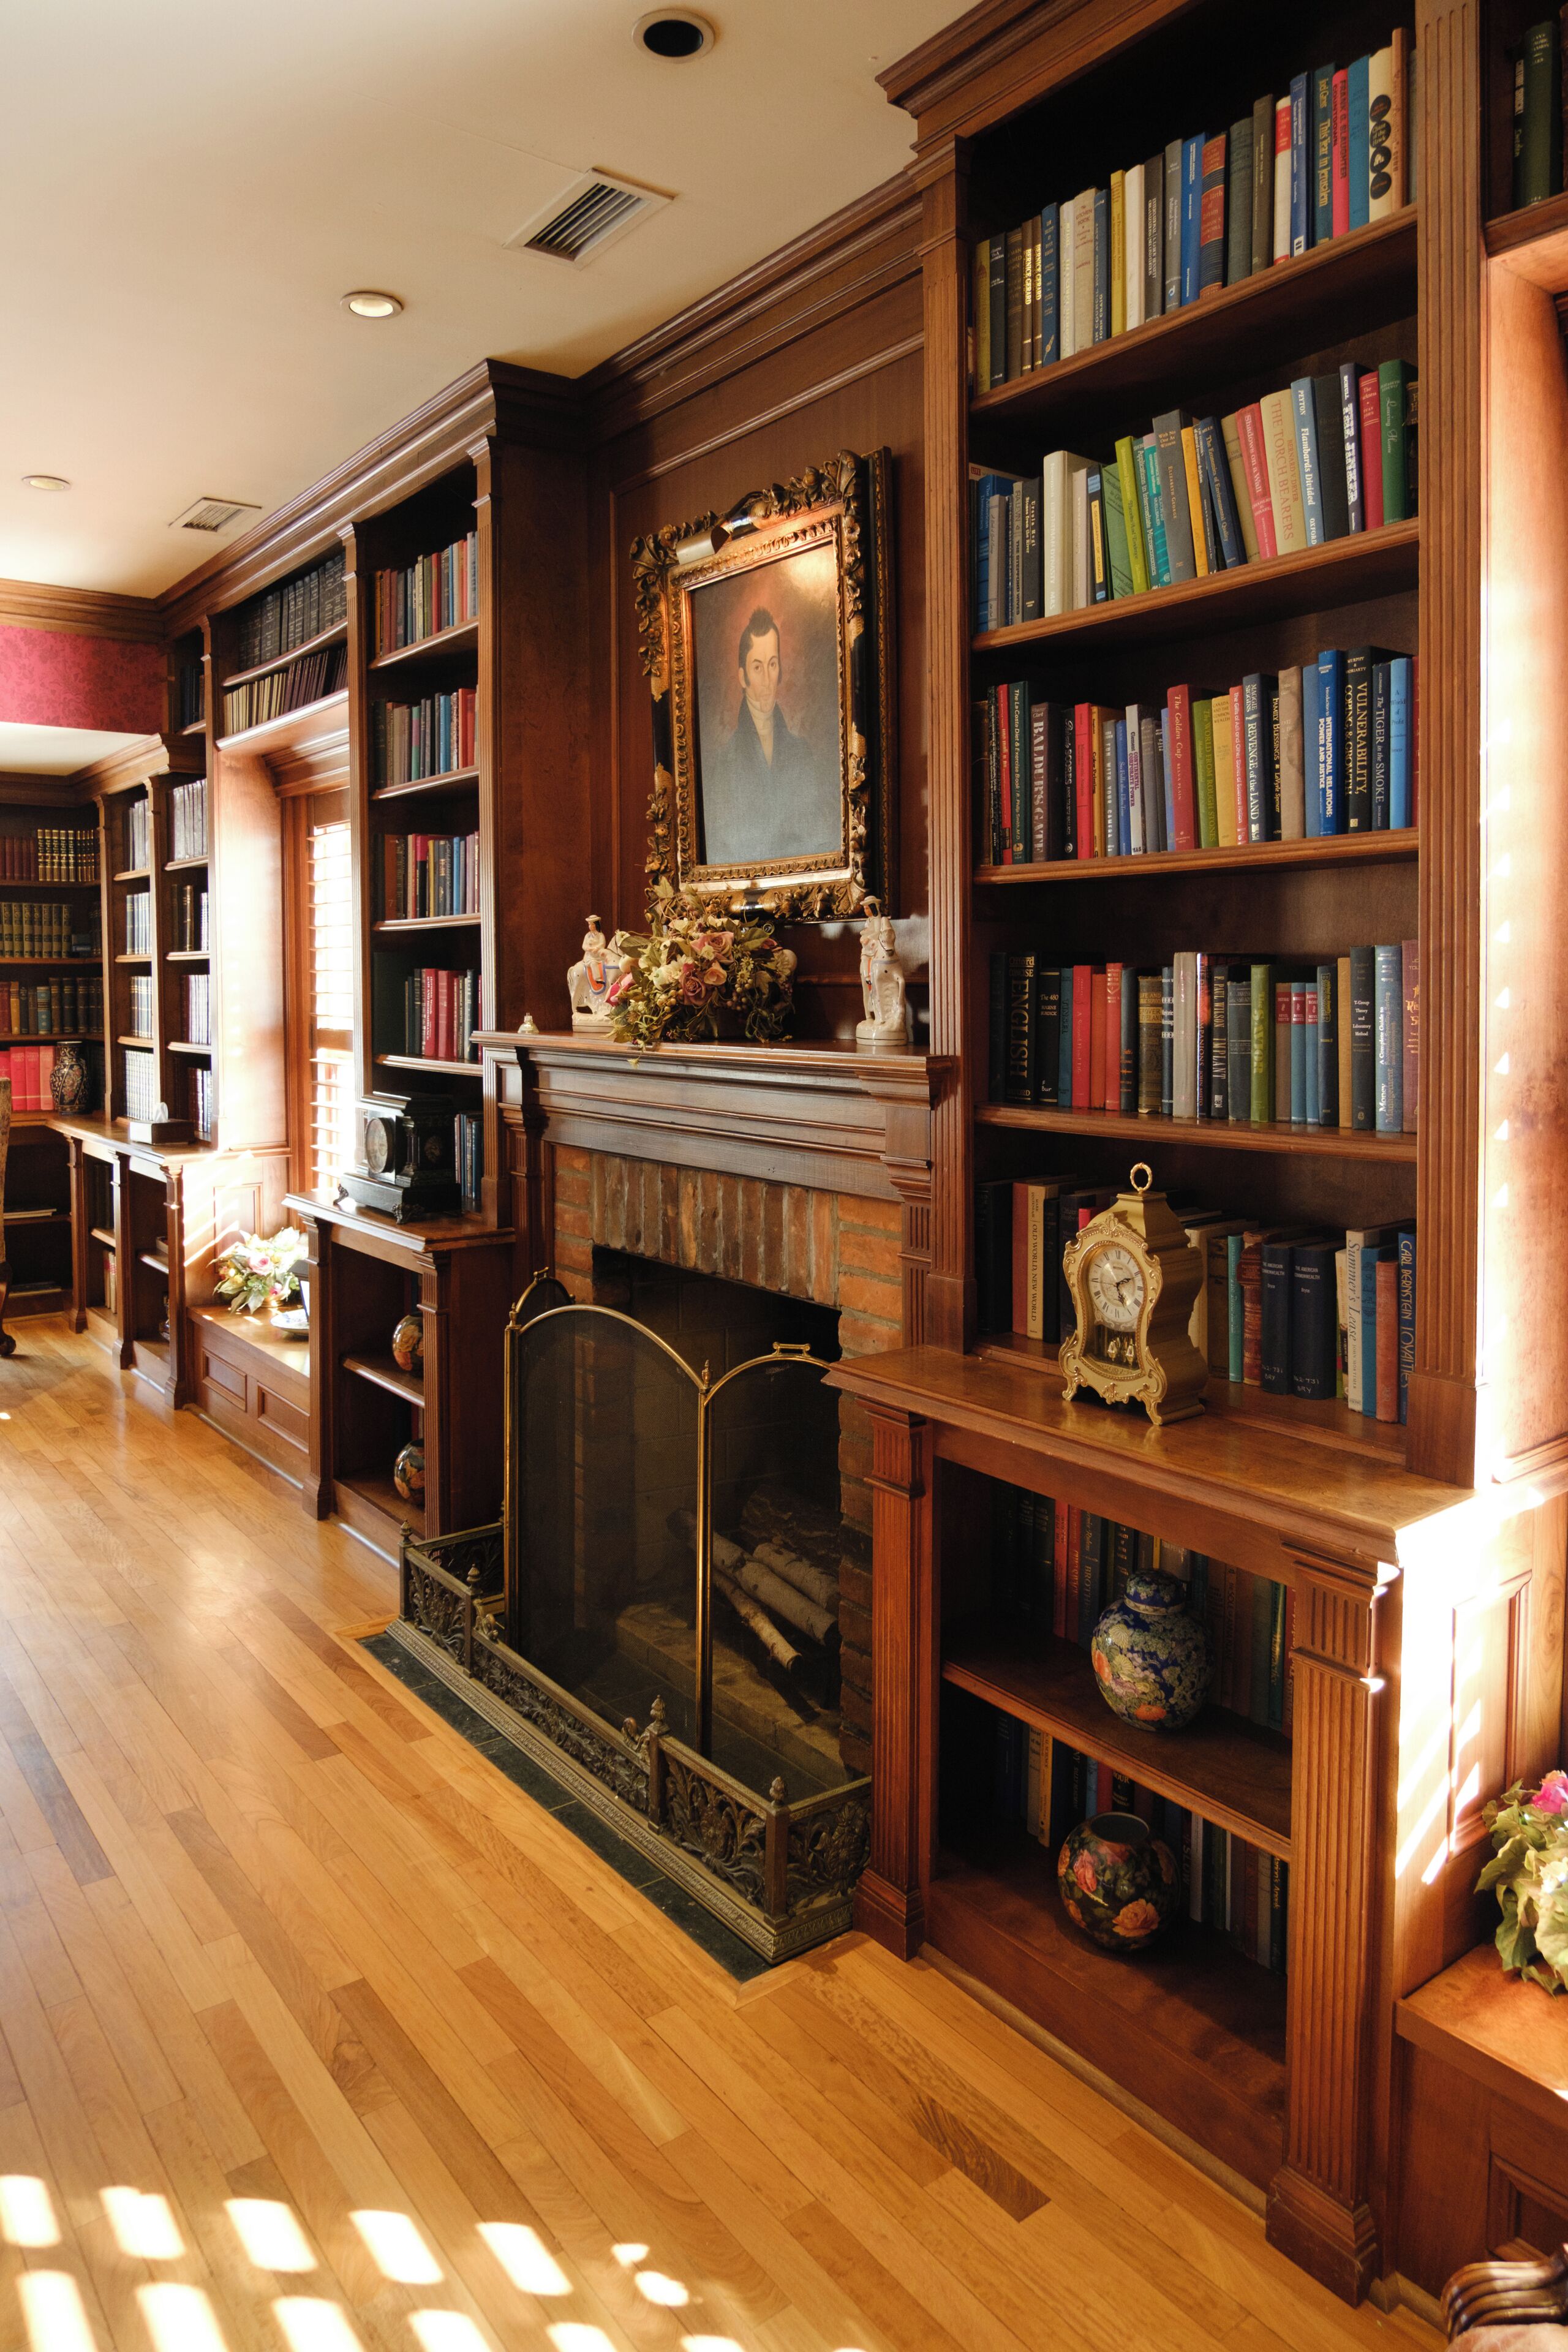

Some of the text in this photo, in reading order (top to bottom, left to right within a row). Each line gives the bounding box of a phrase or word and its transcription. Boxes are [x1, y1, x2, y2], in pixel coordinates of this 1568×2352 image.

[1318, 118, 1330, 207] This Year in Jerusalem
[1386, 397, 1398, 454] Leaving Home
[1137, 450, 1146, 485] Applications
[1244, 415, 1254, 453] Shadows
[1253, 473, 1262, 492] Wall
[1270, 399, 1294, 541] THE TORCH BEARERS
[1300, 428, 1312, 472] Flambards
[1208, 448, 1217, 476] Economics
[1215, 483, 1225, 521] Environmental
[1306, 473, 1316, 505] Divided
[1143, 492, 1152, 528] Intermediate
[1309, 518, 1317, 545] OXFORD
[1147, 529, 1157, 576] Microeconomics
[1248, 722, 1258, 769] REVENGE
[1344, 684, 1352, 795] COPING, & GROWTH
[1354, 682, 1367, 795] VULNERABILITY,
[1376, 708, 1384, 745] TIGER
[1175, 742, 1183, 760] Cup
[1033, 721, 1044, 853] BALDUR'S GATE
[1376, 763, 1385, 803] SMOKE
[1250, 792, 1260, 820] LAND
[1213, 983, 1225, 1000] PAUL
[1010, 979, 1028, 1078] ENGLISH
[1213, 1001, 1225, 1028] WILSON
[1212, 1038, 1226, 1079] IMPLANT
[1385, 1068, 1394, 1123] Management
[1348, 1239, 1361, 1303] Summer's
[1348, 1305, 1360, 1341] Lease
[1400, 1240, 1415, 1389] CARL BERNSTEIN LOYALTIES
[1297, 1385, 1311, 1394] BRY
